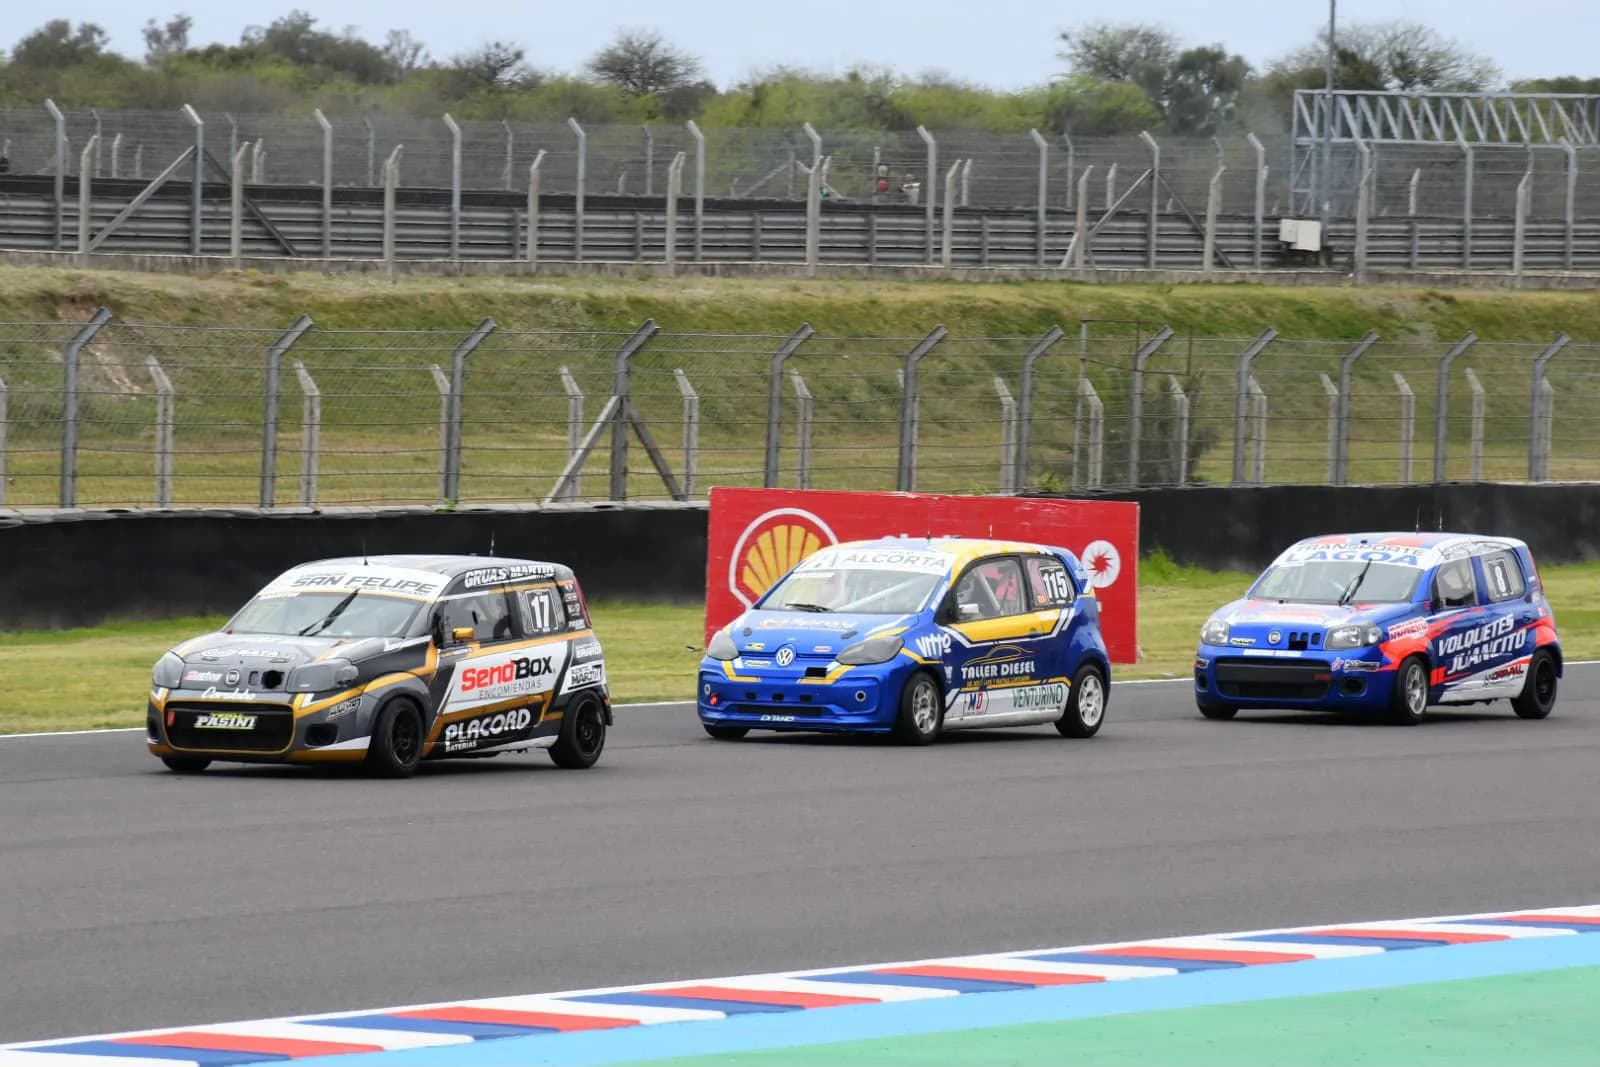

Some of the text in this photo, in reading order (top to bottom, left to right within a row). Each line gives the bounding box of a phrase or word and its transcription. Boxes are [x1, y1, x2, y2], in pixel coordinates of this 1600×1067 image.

[842, 552, 947, 568] ALCORTA
[1285, 550, 1419, 566] LAGOA
[291, 575, 345, 588] SAN
[344, 576, 439, 594] FELIPE
[464, 568, 507, 589] GRUAS
[1043, 571, 1068, 599] 115
[531, 594, 550, 629] 17
[1438, 613, 1515, 657] VOLQUETES
[1446, 628, 1527, 675] JUANCITO
[961, 663, 999, 680] TALLER
[1001, 660, 1036, 676] DIESEL
[479, 679, 543, 700] ENCOMIENDAS
[1011, 684, 1064, 709] VENTURINO
